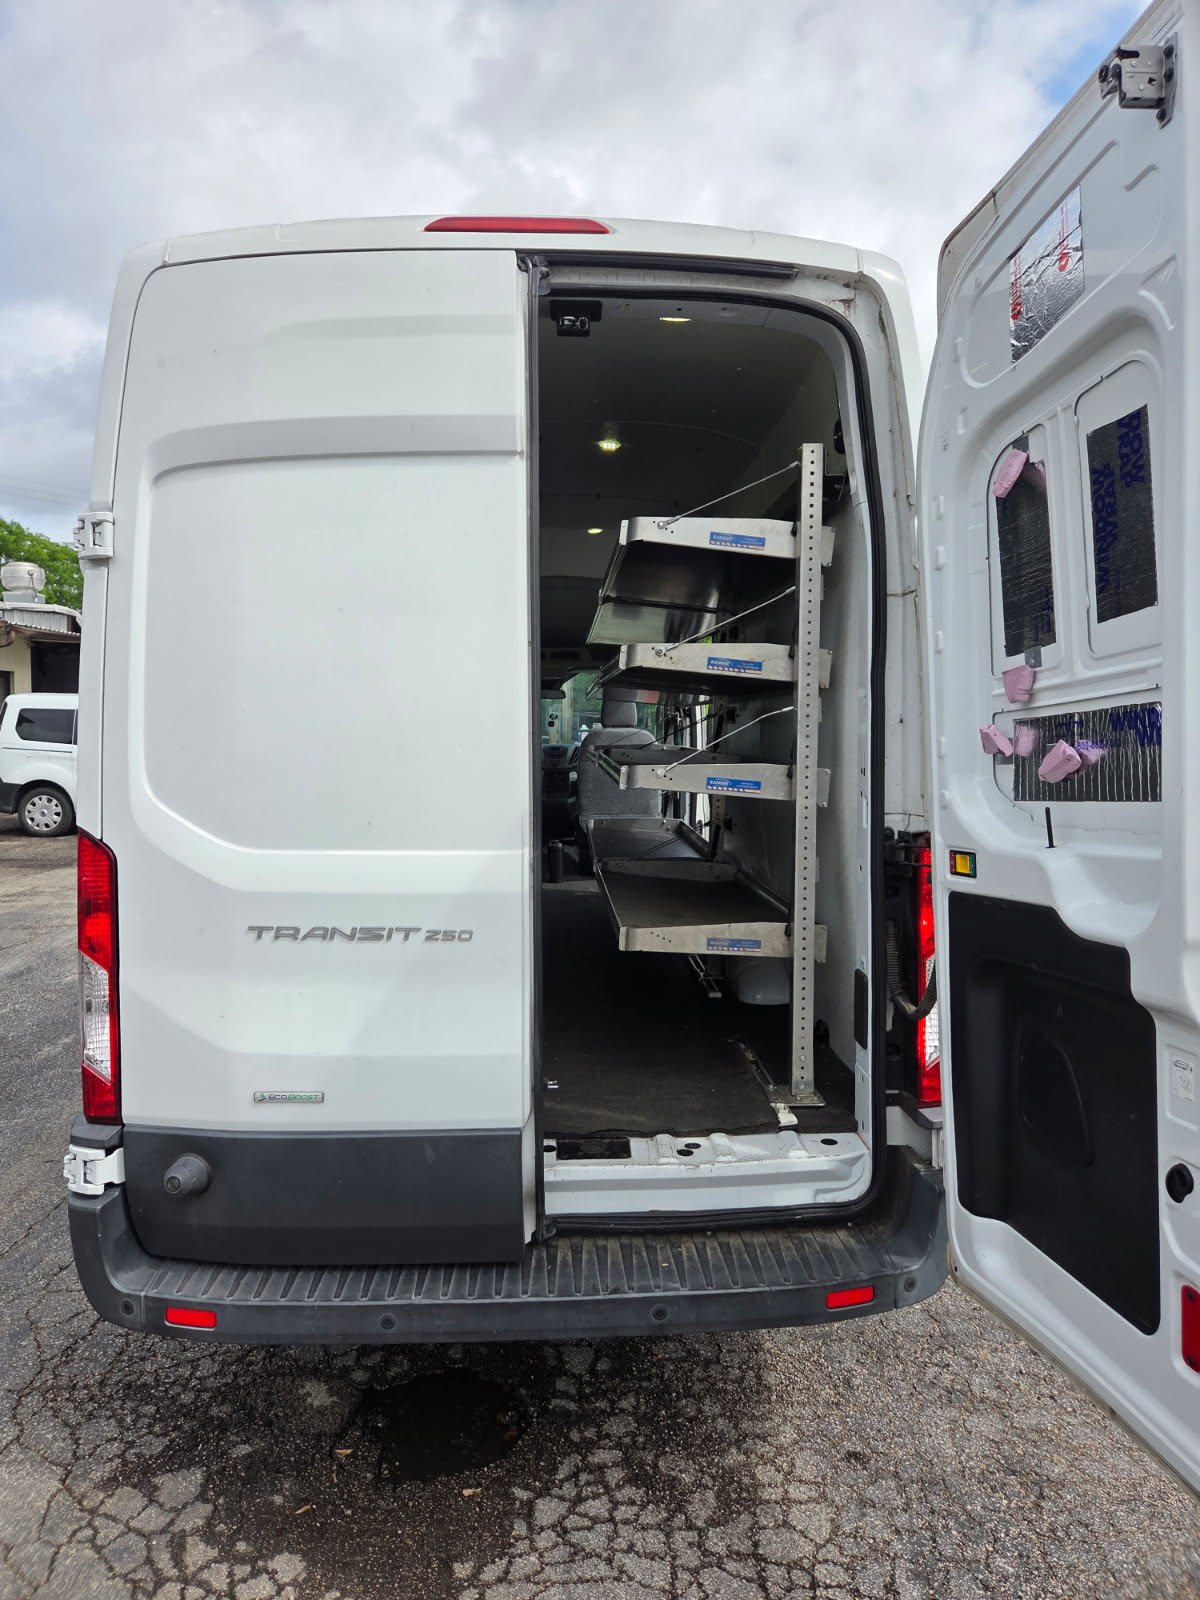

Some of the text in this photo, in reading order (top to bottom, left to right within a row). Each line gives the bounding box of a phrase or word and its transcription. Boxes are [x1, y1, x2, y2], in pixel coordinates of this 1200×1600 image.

[1092, 467, 1110, 595] WINDOW
[247, 926, 474, 942] TRANSIT 250
